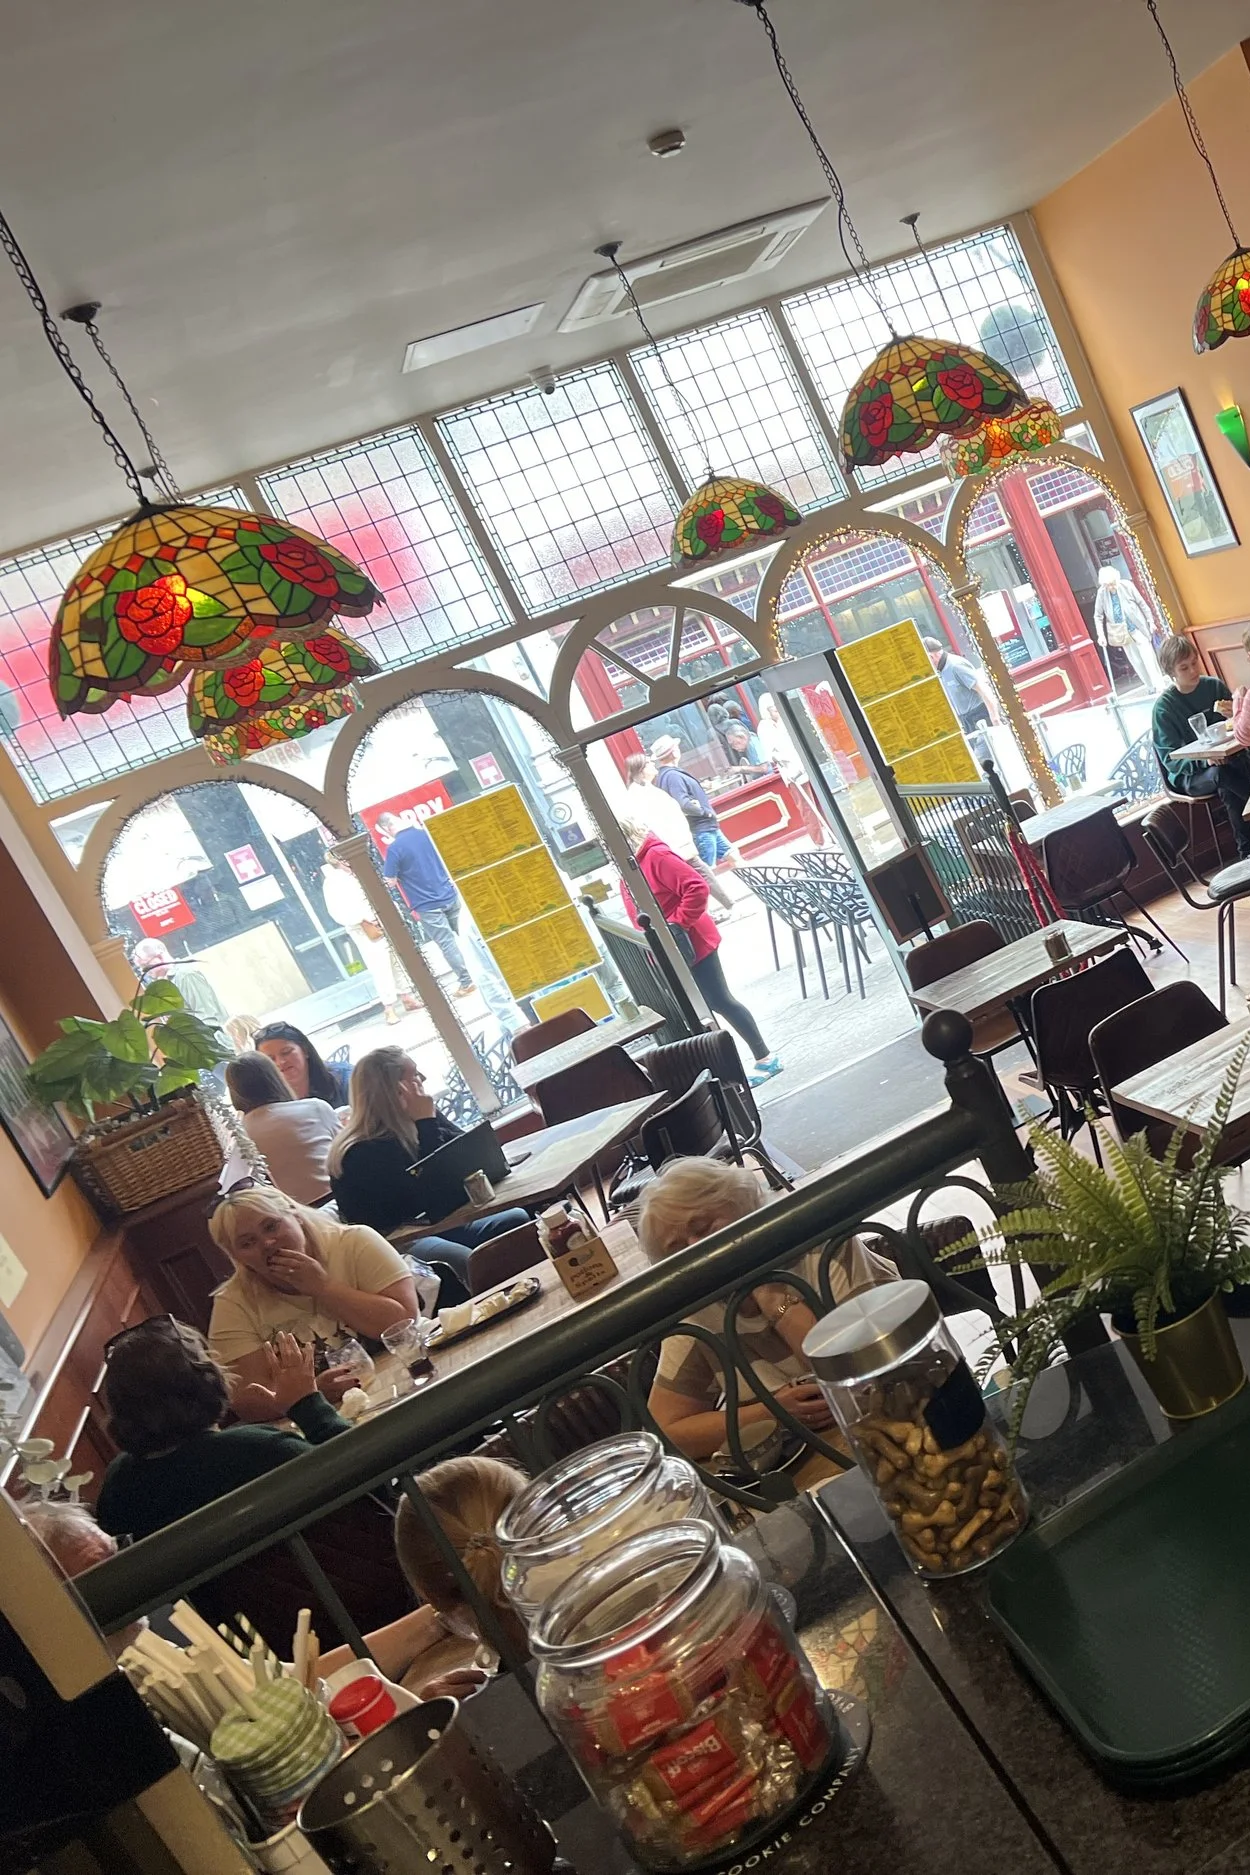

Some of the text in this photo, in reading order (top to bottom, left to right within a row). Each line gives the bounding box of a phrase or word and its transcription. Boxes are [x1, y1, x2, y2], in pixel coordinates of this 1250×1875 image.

[375, 796, 445, 846] SRRY
[717, 1746, 861, 1875] OOKIE COMPANY
